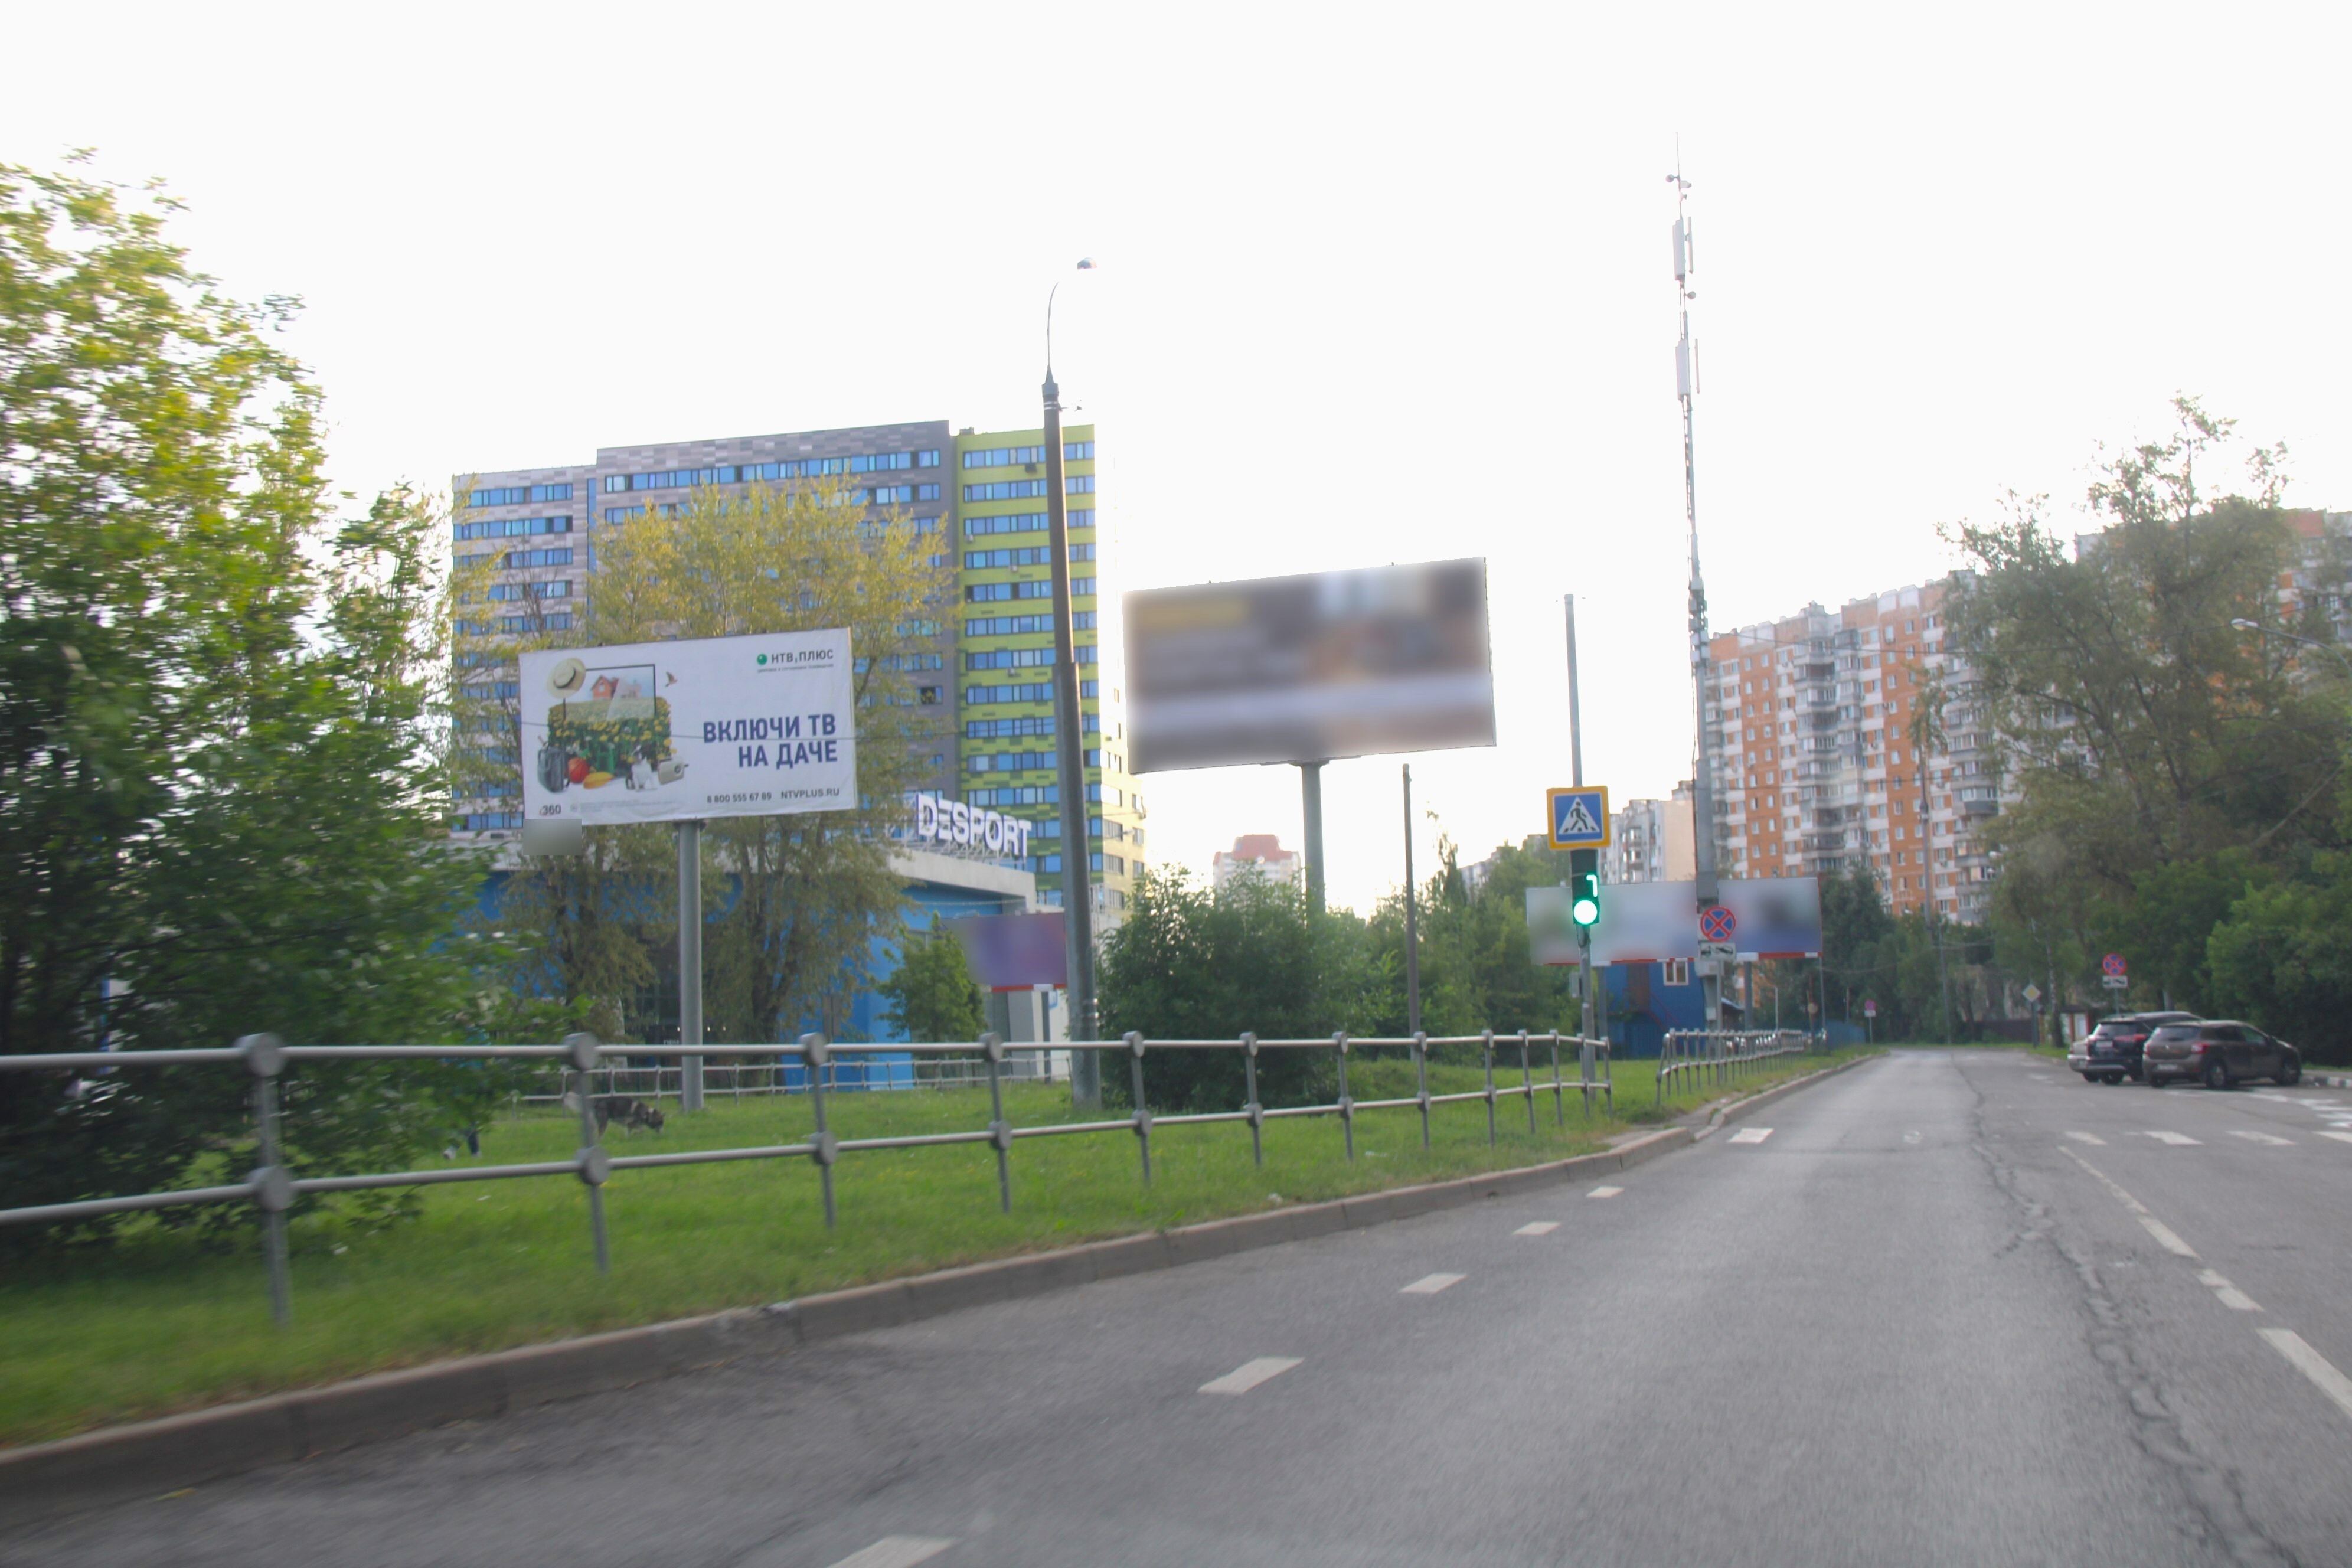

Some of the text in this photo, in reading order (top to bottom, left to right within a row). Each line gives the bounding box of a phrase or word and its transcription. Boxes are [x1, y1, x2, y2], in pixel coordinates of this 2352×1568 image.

[703, 713, 836, 743] ВКЛЮЧИ ТВ
[739, 740, 838, 770] НА ДАЧЕ
[714, 794, 730, 803] 800
[733, 793, 747, 802] 555
[749, 793, 759, 801] 67
[781, 788, 839, 799] NTVPLUS.RU
[916, 793, 1032, 857] DESPORT
